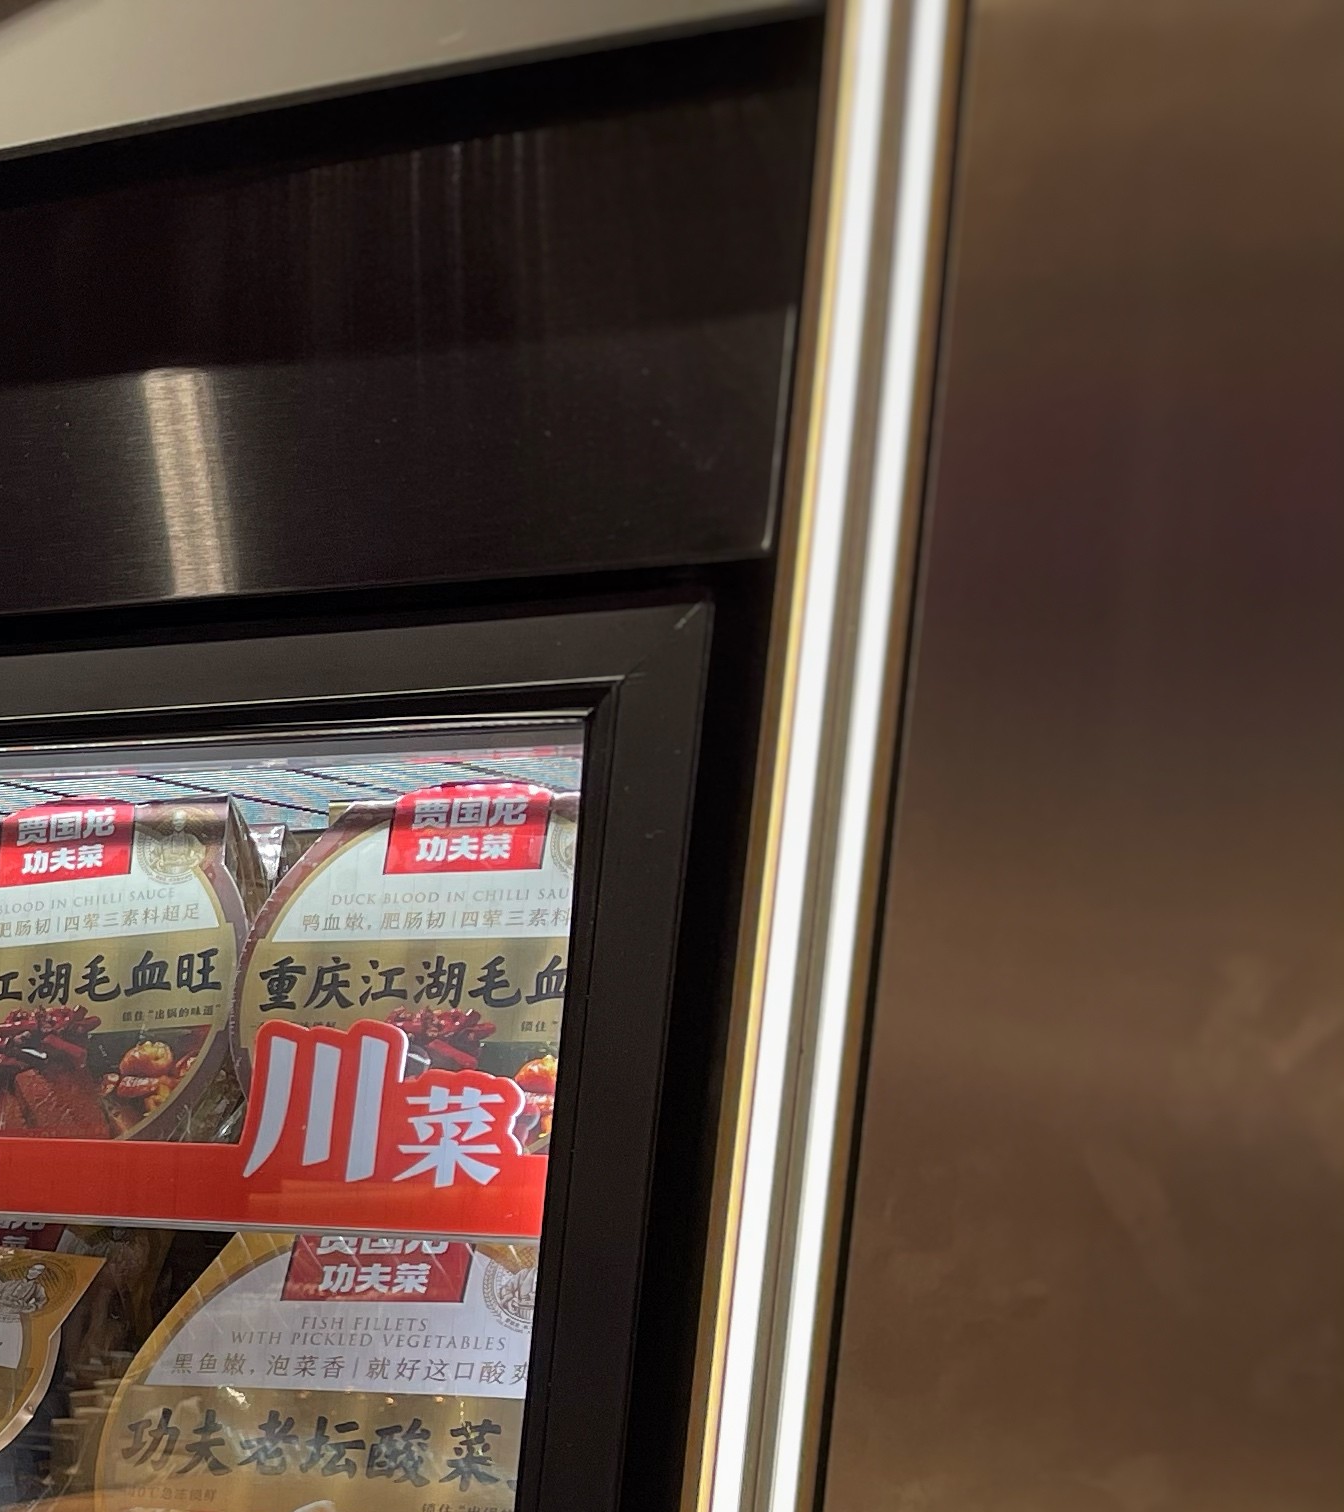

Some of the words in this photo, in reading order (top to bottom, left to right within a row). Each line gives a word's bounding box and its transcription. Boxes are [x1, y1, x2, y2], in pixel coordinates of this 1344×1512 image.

[17, 807, 115, 846] 贾国龙
[413, 796, 529, 829] 贾国龙
[22, 845, 104, 875] 功夫菜
[415, 833, 512, 862] 功夫菜
[51, 899, 67, 910] IN
[74, 893, 123, 908] CHILLI
[129, 887, 176, 902] SAUCE
[331, 894, 376, 907] DUCK
[384, 891, 440, 905] BLOOD
[447, 890, 464, 902] IN
[472, 888, 531, 901] CHILLI
[258, 955, 568, 1012] 重庆江湖毛血
[243, 1035, 506, 1189] 川菜
[321, 1264, 432, 1294] 功夫菜
[302, 1316, 344, 1331] FISH
[355, 1316, 429, 1332] FILLETS
[231, 1331, 281, 1345] WITH
[291, 1332, 373, 1347] PICKLED
[383, 1334, 506, 1351] VEGETABLES
[121, 1408, 516, 1492] 功夫老坛酸菜
